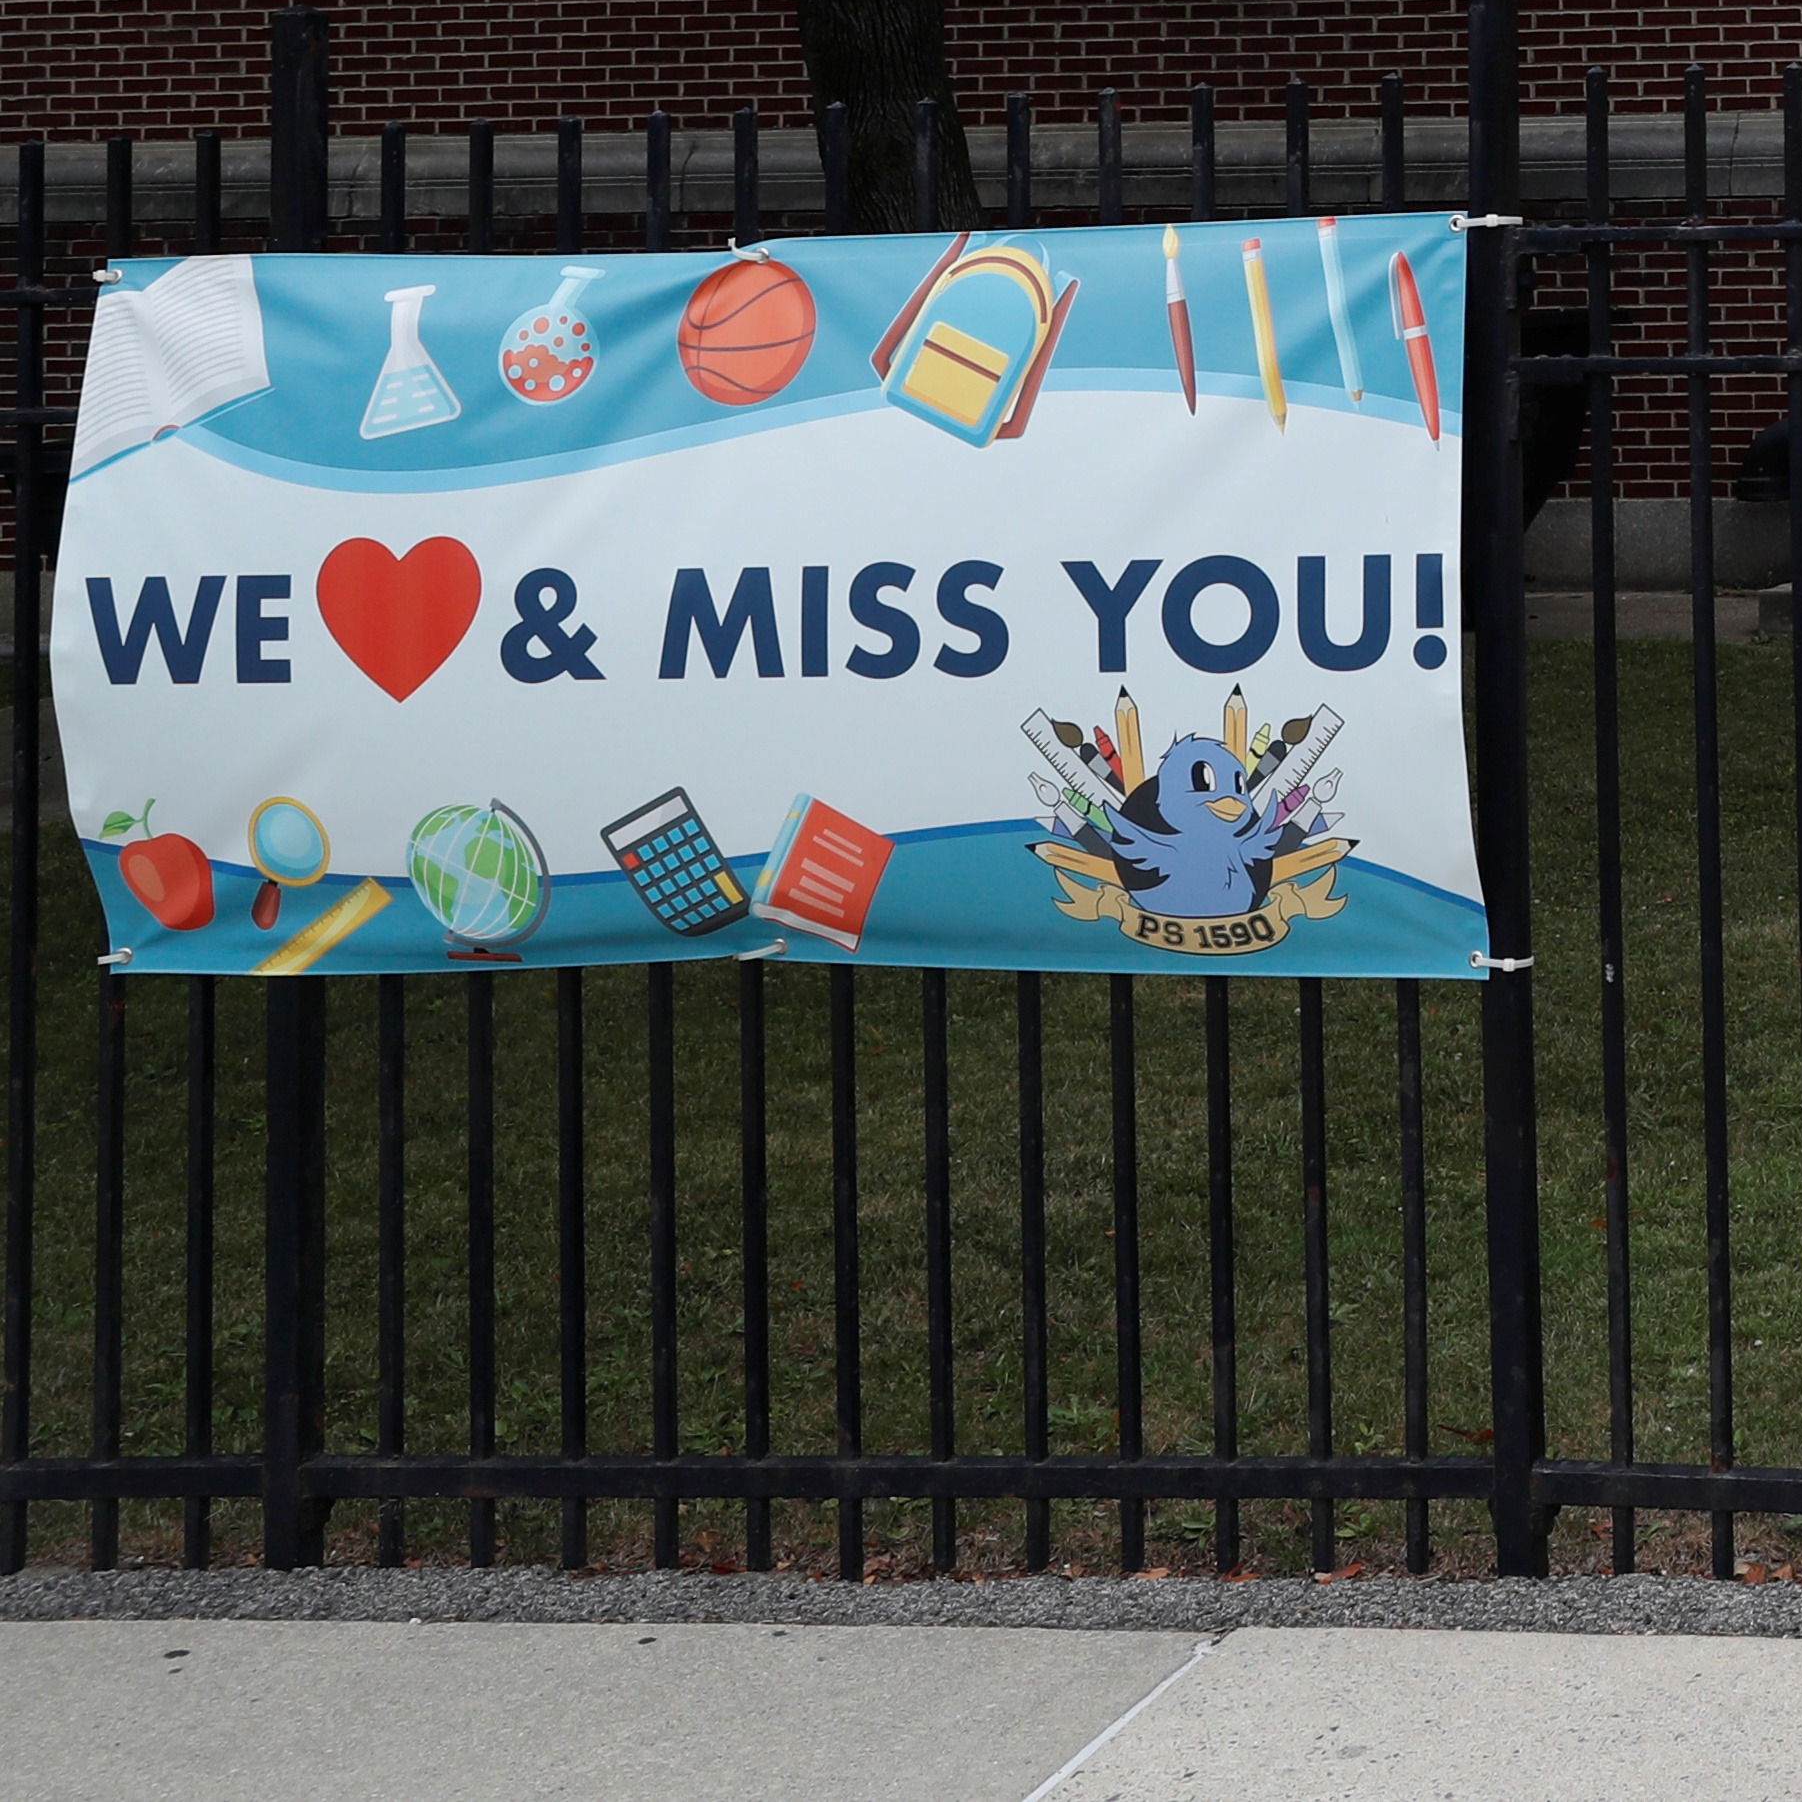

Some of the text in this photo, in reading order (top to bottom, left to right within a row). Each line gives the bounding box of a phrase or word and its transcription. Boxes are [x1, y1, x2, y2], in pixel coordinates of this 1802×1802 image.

[85, 553, 1448, 685] WE & MISS YOU!
[1135, 912, 1276, 949] PS 159Q
